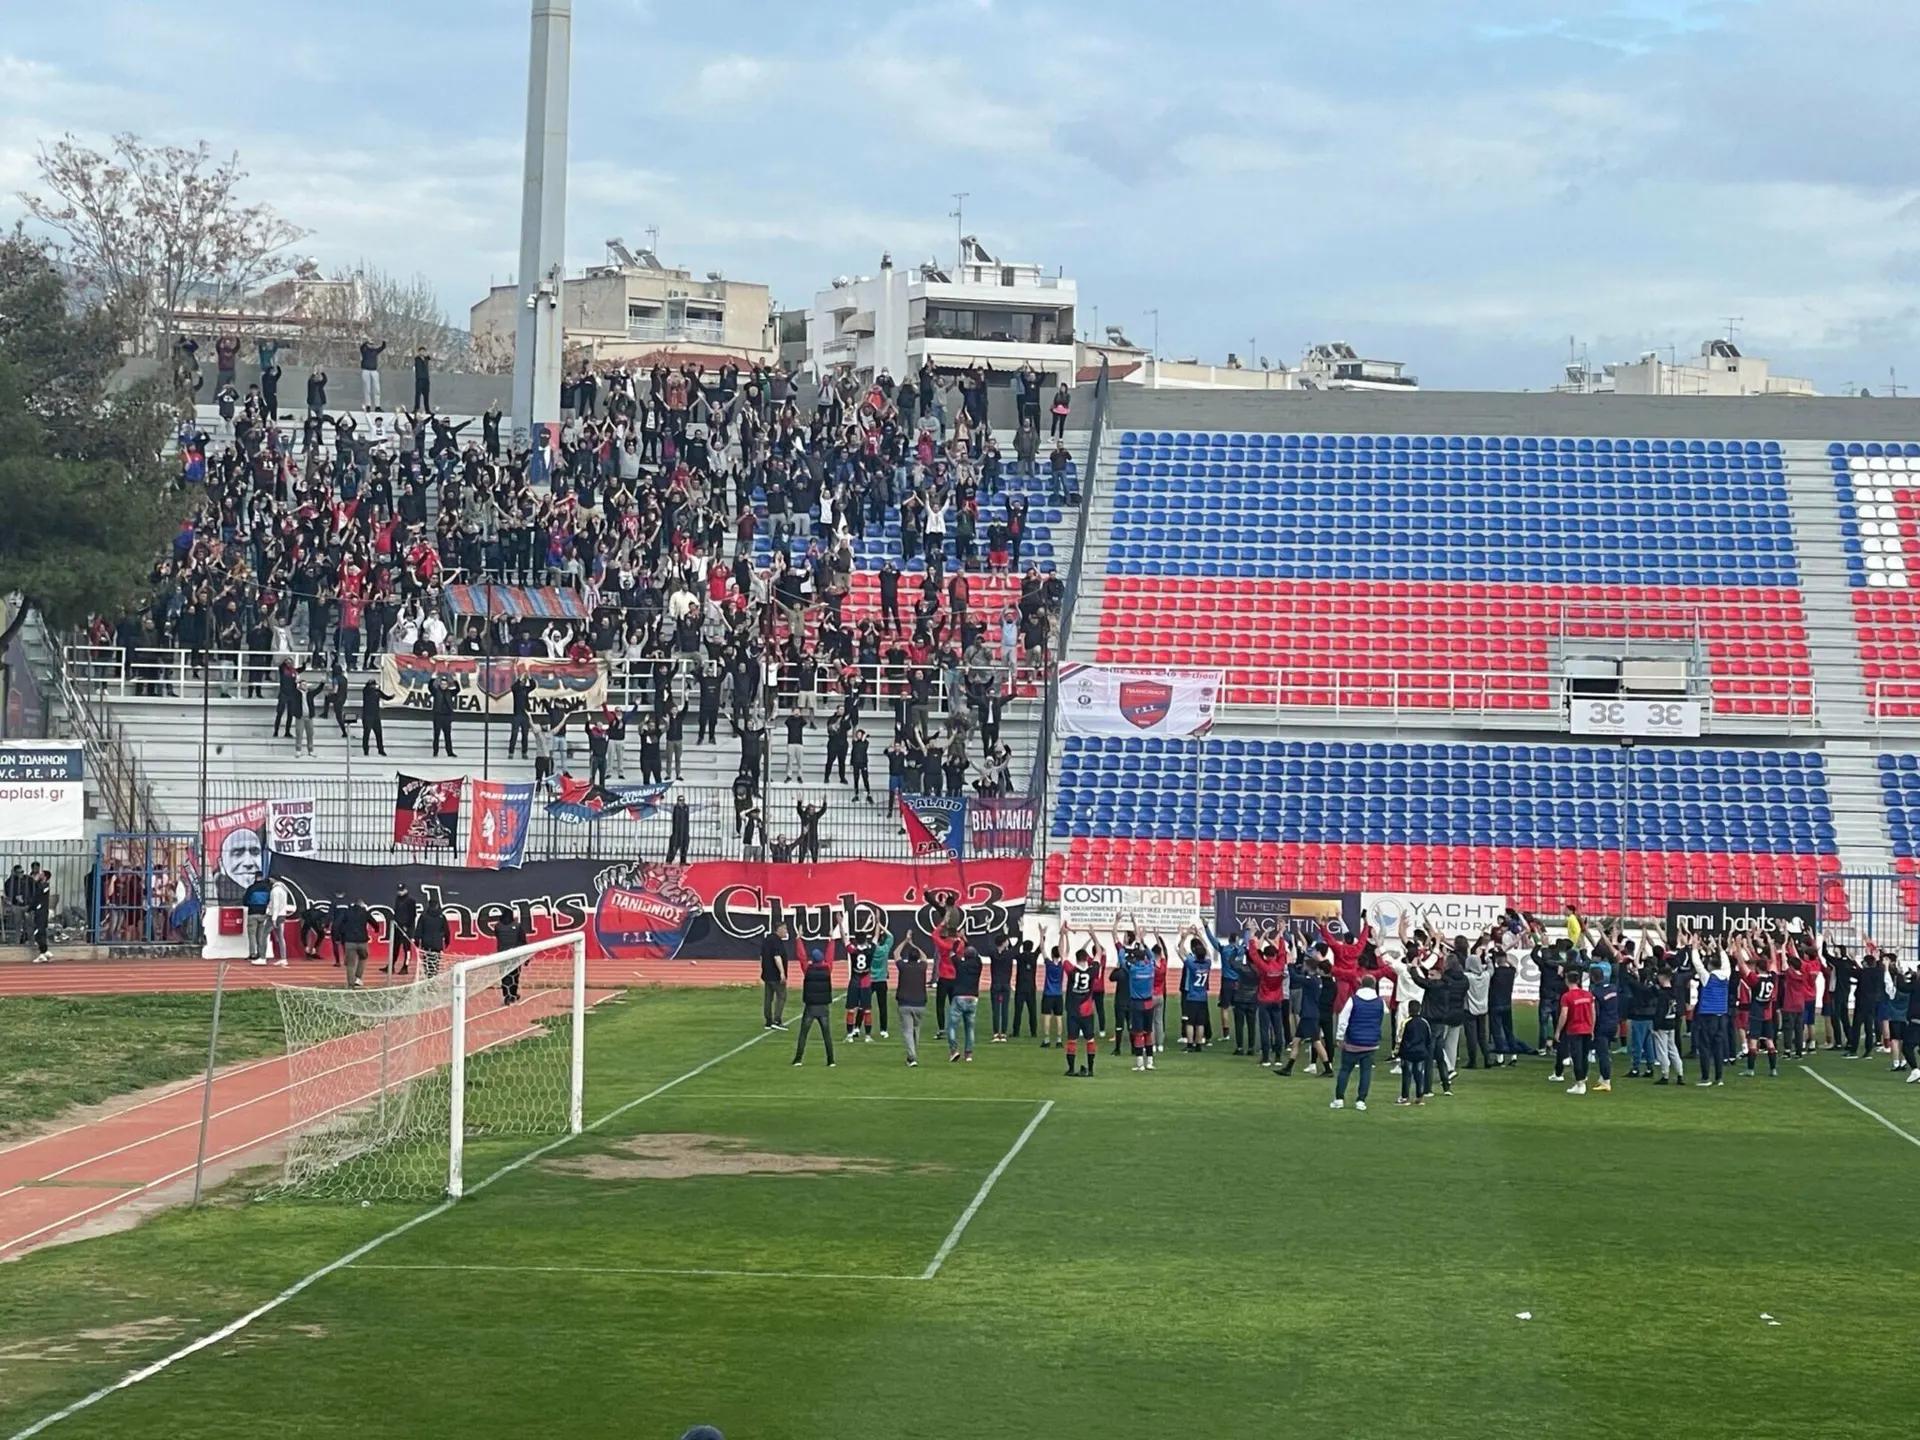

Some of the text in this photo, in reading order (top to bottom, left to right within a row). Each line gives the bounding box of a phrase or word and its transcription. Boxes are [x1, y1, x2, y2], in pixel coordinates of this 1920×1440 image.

[19, 755, 68, 765] ΣΩΛΗΝΩΝ
[25, 769, 44, 779] P.E.
[50, 769, 68, 779] P.P.
[0, 787, 65, 802] aplast.gr
[280, 876, 588, 944] nhers
[712, 884, 888, 941] Club
[611, 892, 685, 924] ΠΑΝΙΩΝΙΟΣ
[1239, 901, 1289, 912] ATHENS
[1409, 902, 1500, 918] YACHT
[1414, 921, 1493, 931] LUNDRY
[1676, 906, 1777, 932] mini habits
[856, 954, 867, 970] 8
[1073, 972, 1091, 990] 13
[1758, 981, 1774, 999] 19
